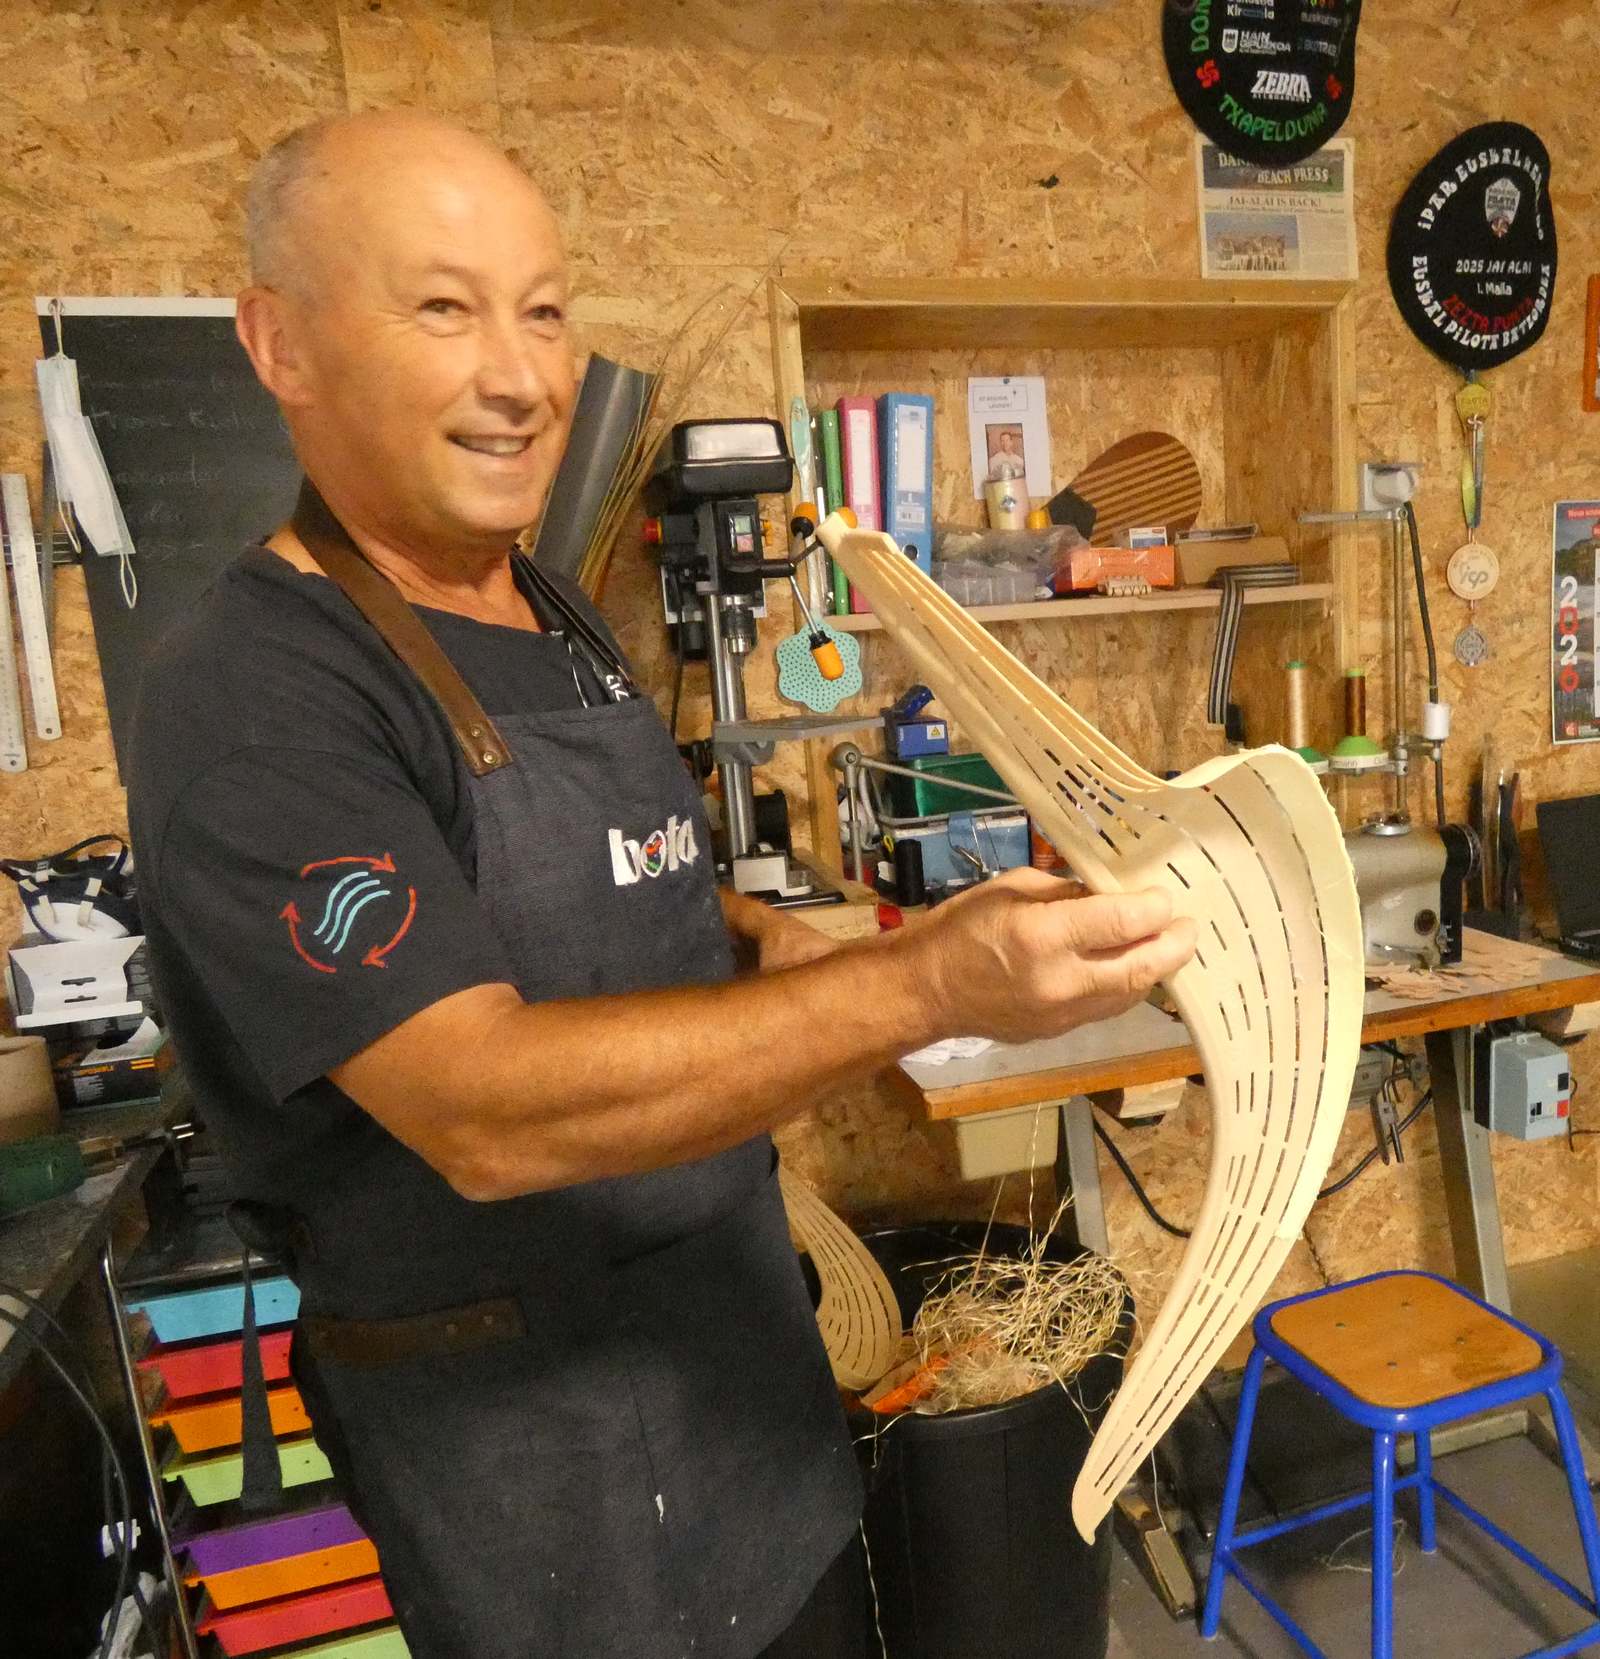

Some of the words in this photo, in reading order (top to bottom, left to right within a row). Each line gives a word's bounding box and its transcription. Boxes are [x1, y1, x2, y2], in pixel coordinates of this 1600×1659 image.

[1250, 69, 1312, 101] ZEBRA
[1219, 93, 1328, 141] TXAPELDUNA
[1257, 169, 1292, 184] BEACH
[1293, 167, 1329, 183] PRESS
[1455, 259, 1485, 273] 2025
[1486, 260, 1506, 274] JAI
[1507, 260, 1532, 274] ALAI
[1412, 255, 1447, 328] EUSKAL
[1557, 575, 1581, 694] 2026
